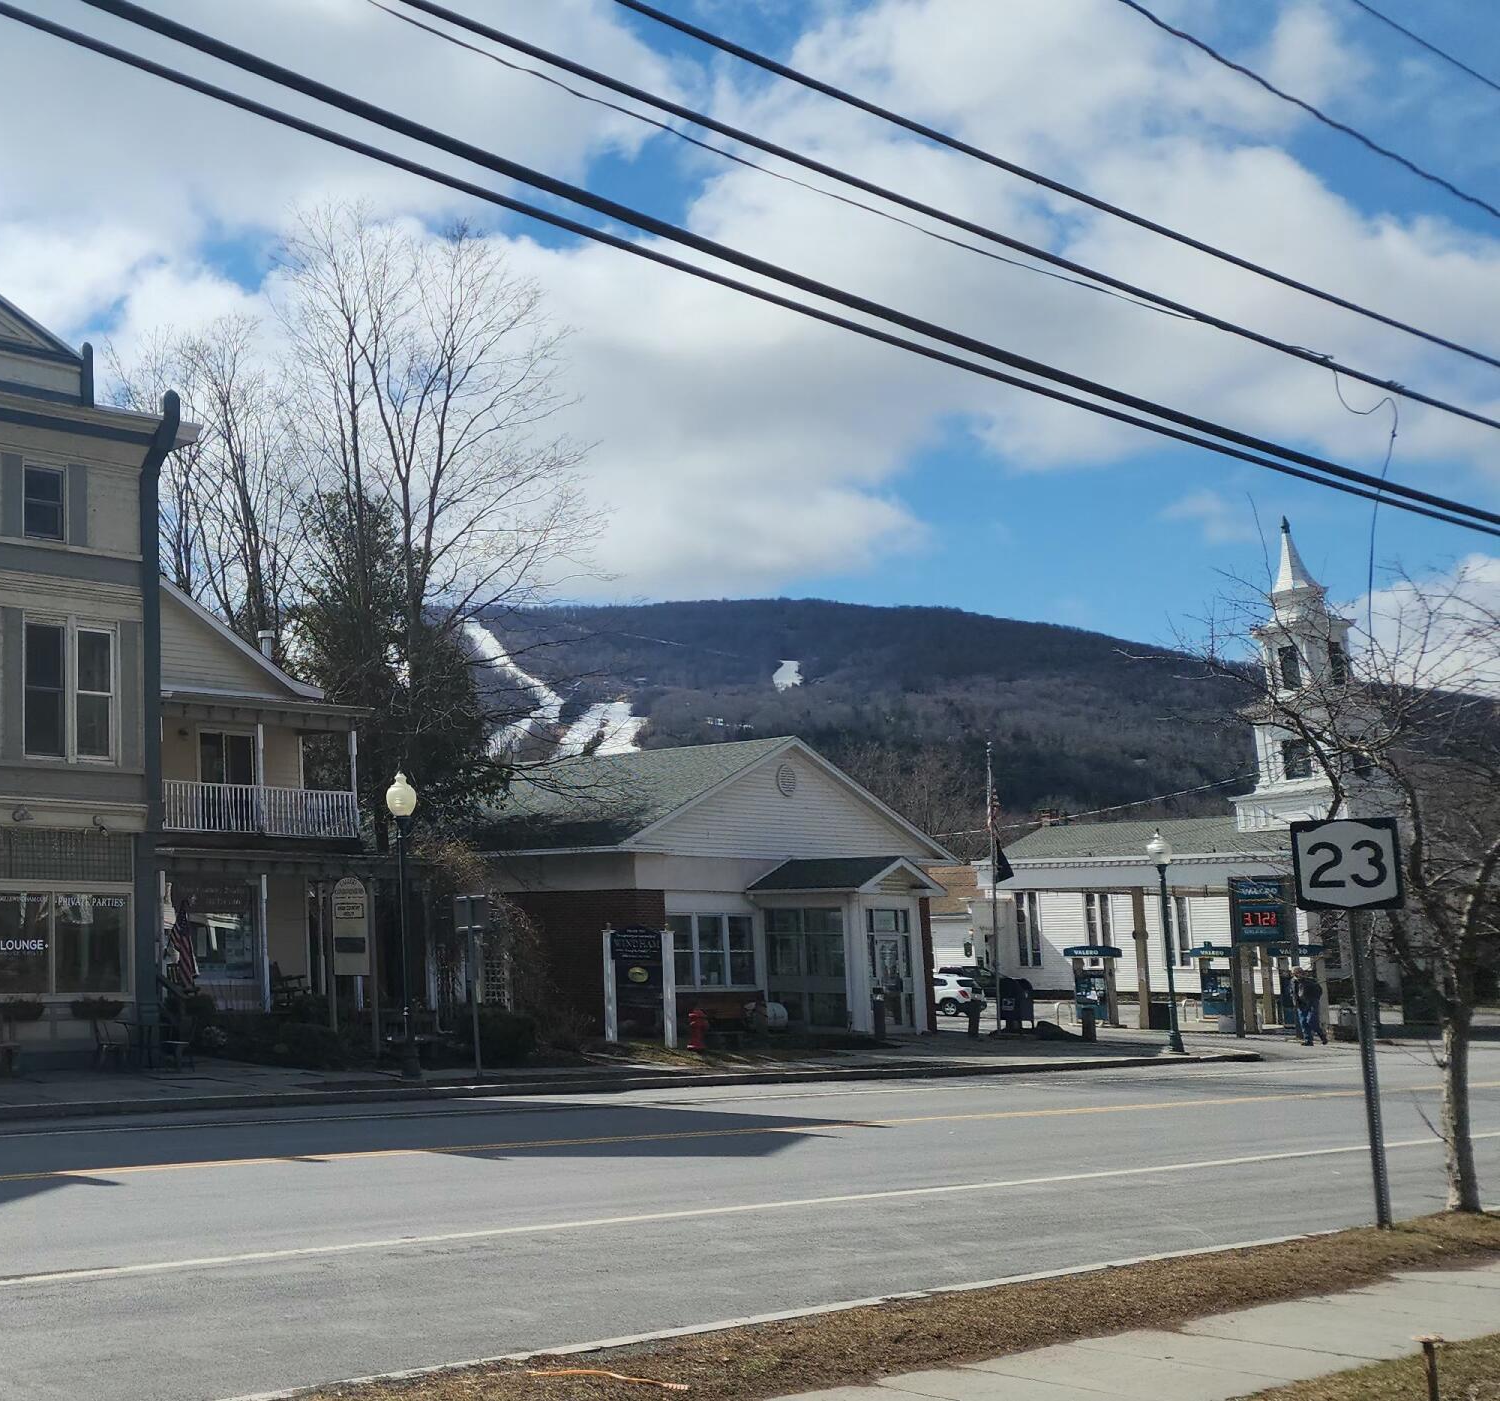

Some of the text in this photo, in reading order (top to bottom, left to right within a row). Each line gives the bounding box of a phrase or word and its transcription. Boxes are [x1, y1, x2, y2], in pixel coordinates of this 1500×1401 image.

[1306, 839, 1388, 889] 23
[92, 896, 124, 908] PARTIES
[0, 940, 44, 951] LOUNGE
[1073, 949, 1099, 957] VALERO
